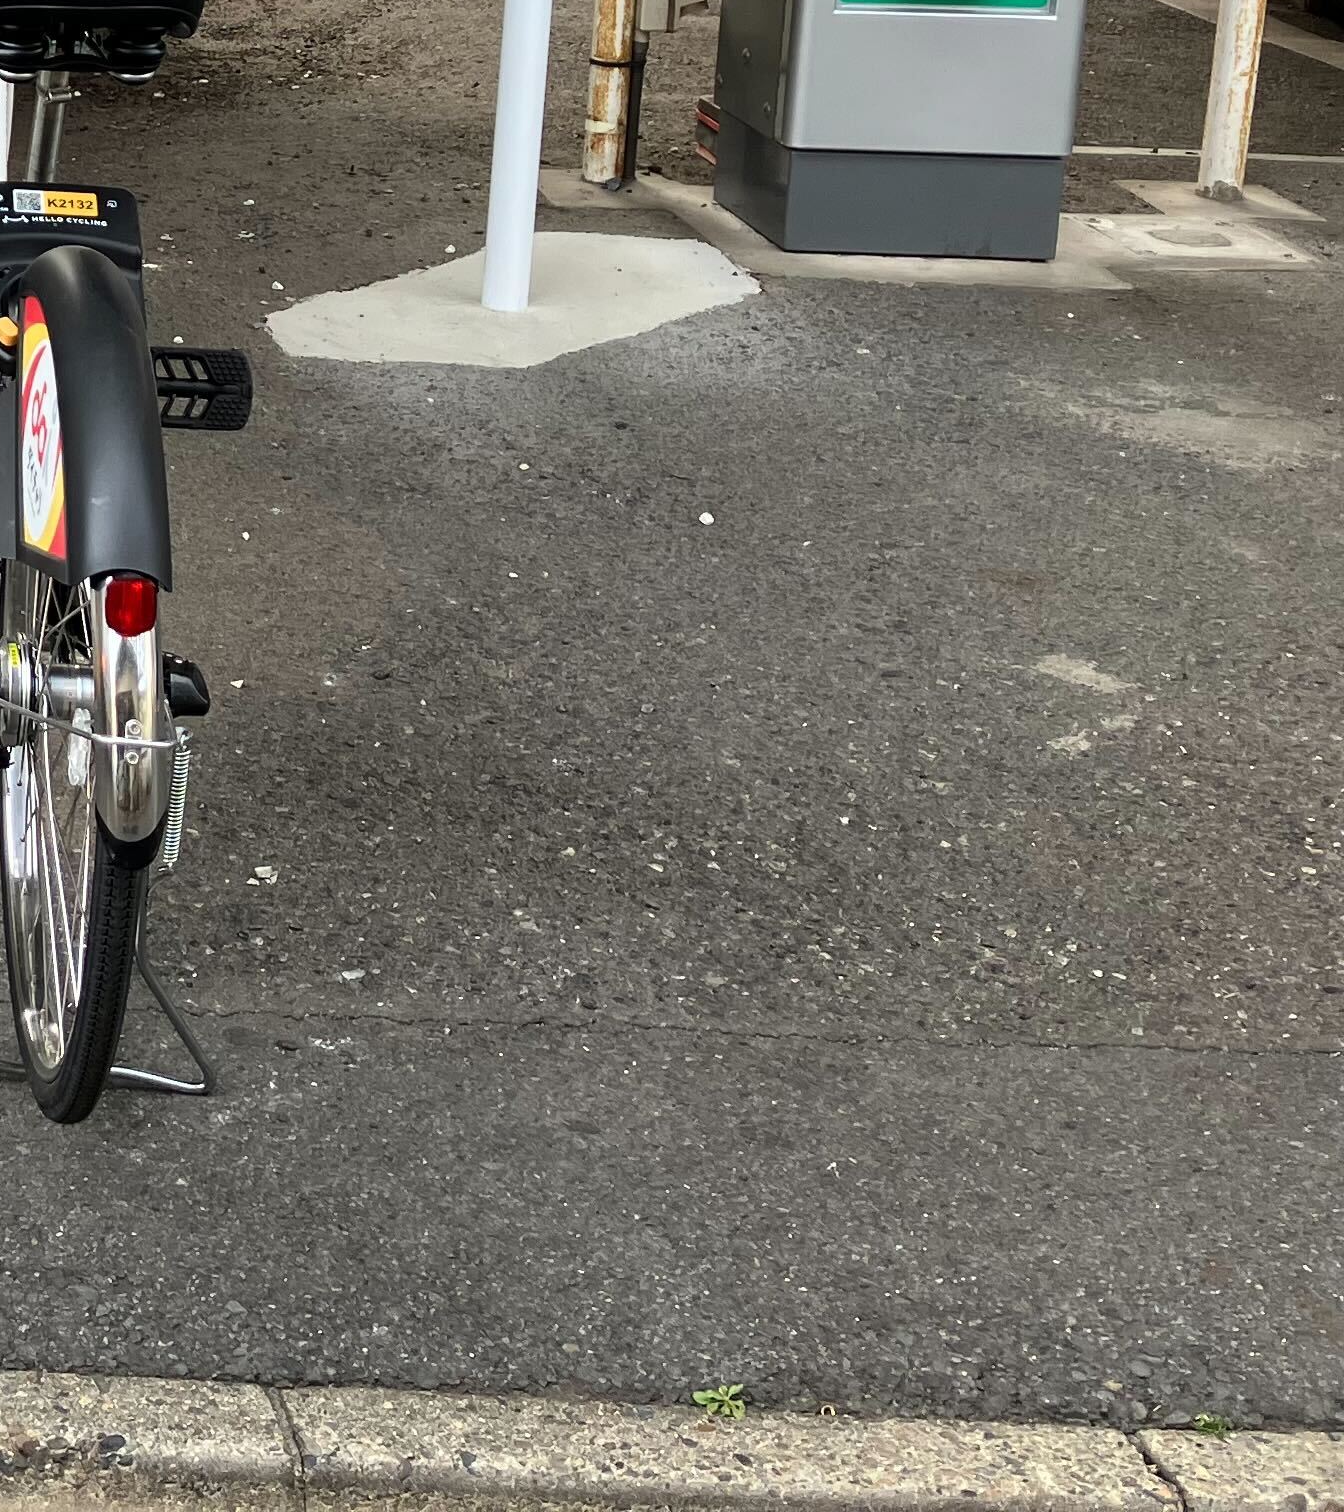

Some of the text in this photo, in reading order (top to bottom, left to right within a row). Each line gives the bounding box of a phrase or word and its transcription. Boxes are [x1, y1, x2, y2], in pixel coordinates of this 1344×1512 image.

[47, 198, 93, 210] K2132
[31, 215, 108, 227] HELLO CYCLING
